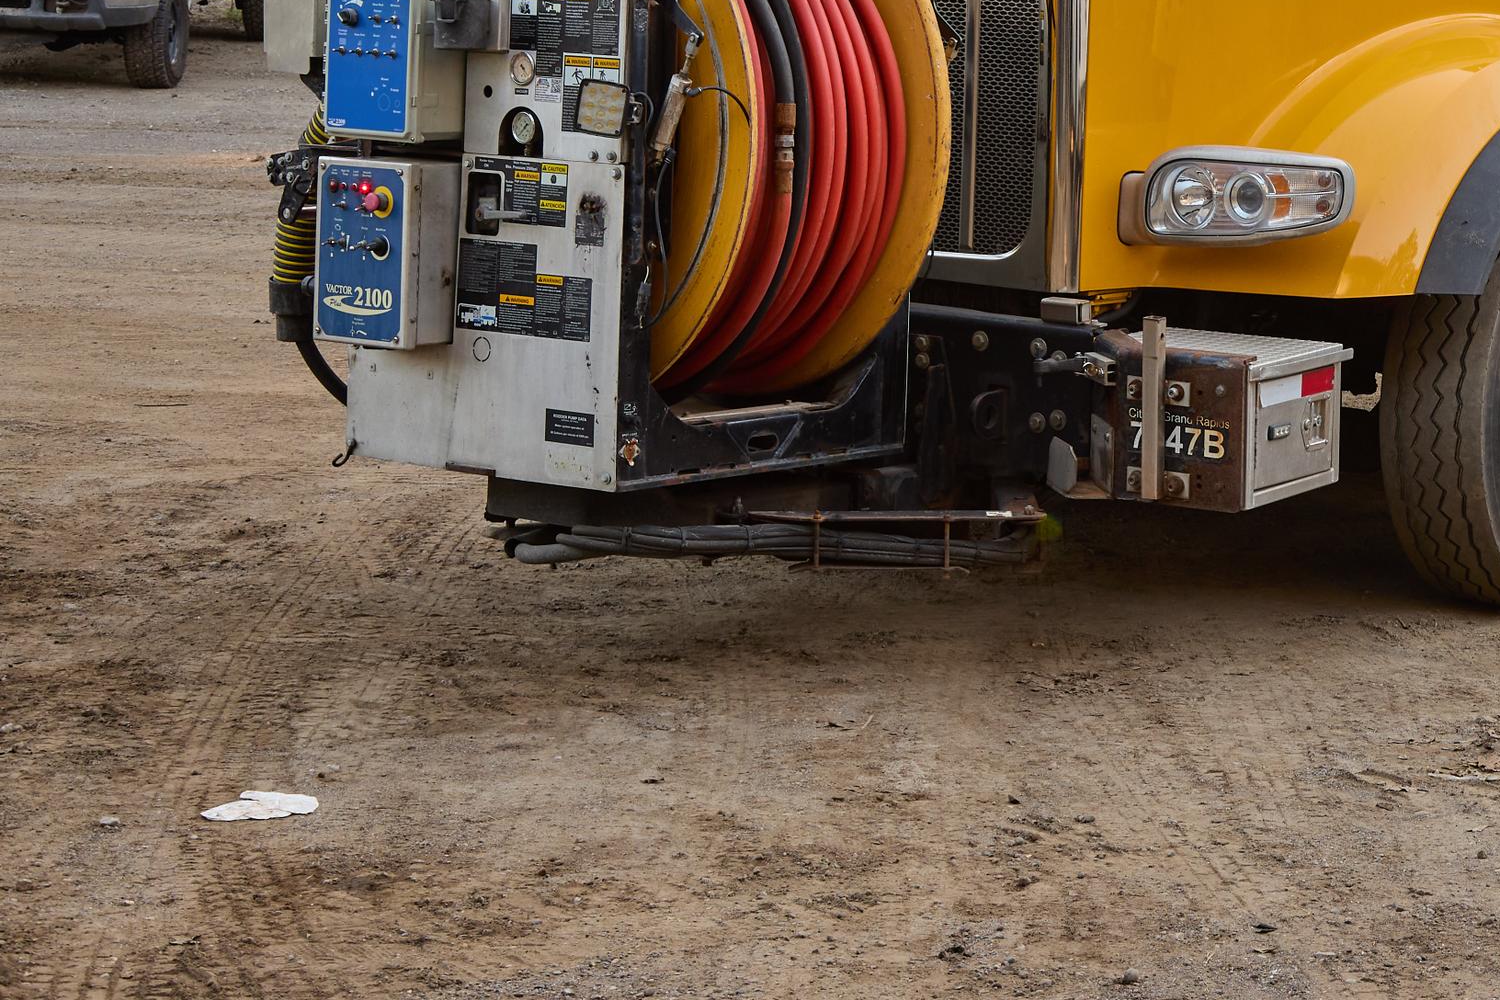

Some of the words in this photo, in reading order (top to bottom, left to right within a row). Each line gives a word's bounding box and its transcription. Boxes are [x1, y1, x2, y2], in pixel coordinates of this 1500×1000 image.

[546, 165, 566, 173] CAUTION
[542, 277, 562, 285] WARNING
[326, 283, 353, 295] VACTOR
[353, 286, 393, 309] 2100
[1128, 407, 1143, 418] Cit
[1196, 415, 1231, 430] Rapids
[1130, 421, 1225, 459] 747B
